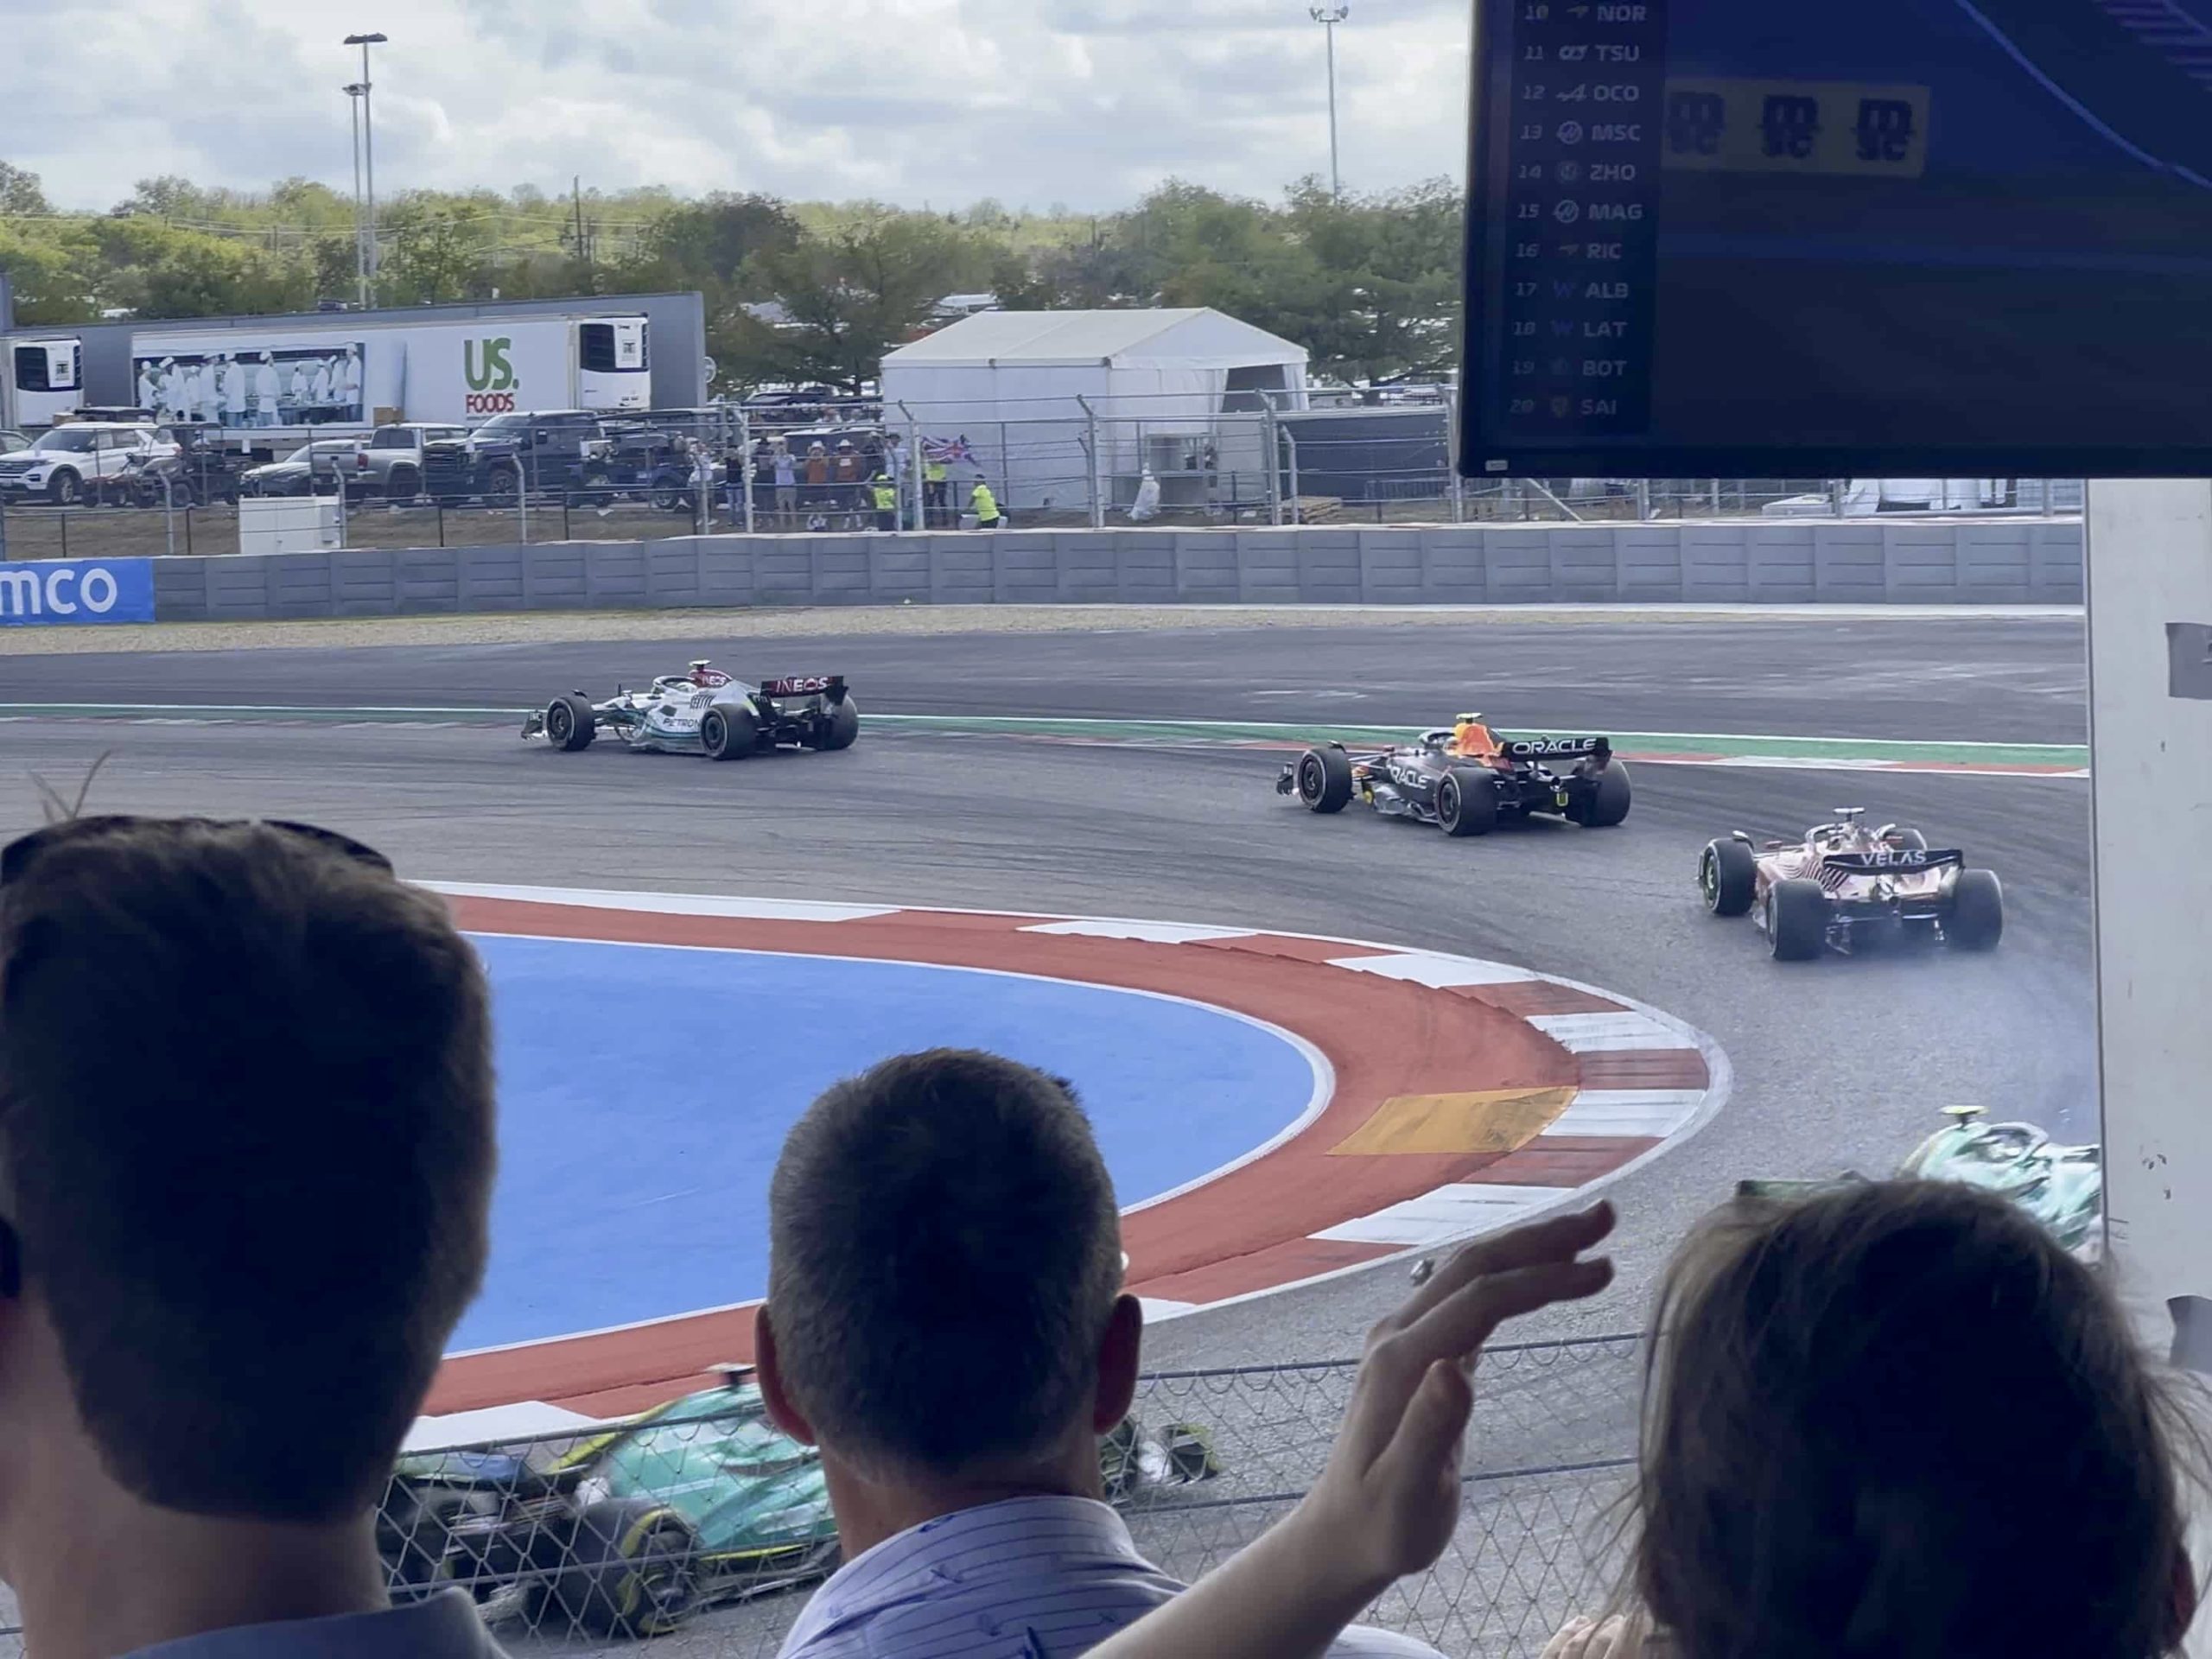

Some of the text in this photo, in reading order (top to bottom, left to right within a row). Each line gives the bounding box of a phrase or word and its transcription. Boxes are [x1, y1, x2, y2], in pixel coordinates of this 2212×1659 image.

[1596, 4, 1647, 22] NOR
[1523, 45, 1640, 61] 11 TSU
[1523, 85, 1639, 101] 12 OCO
[1520, 124, 1641, 142] 13 MSC
[1517, 164, 1636, 181] 14 ZHO
[1517, 204, 1643, 220] 15 MAG
[1515, 243, 1622, 259] 16 RIC
[1514, 283, 1537, 296] 17
[1585, 283, 1629, 298] ALB
[1513, 321, 1536, 336] 18
[1583, 321, 1629, 338] LAT
[1582, 359, 1628, 377] BOT
[466, 393, 515, 413] FOODS
[1580, 399, 1617, 415] SAI
[775, 677, 829, 693] INEOS
[1512, 737, 1598, 755] ORACLE
[1860, 850, 1927, 866] VELAS
